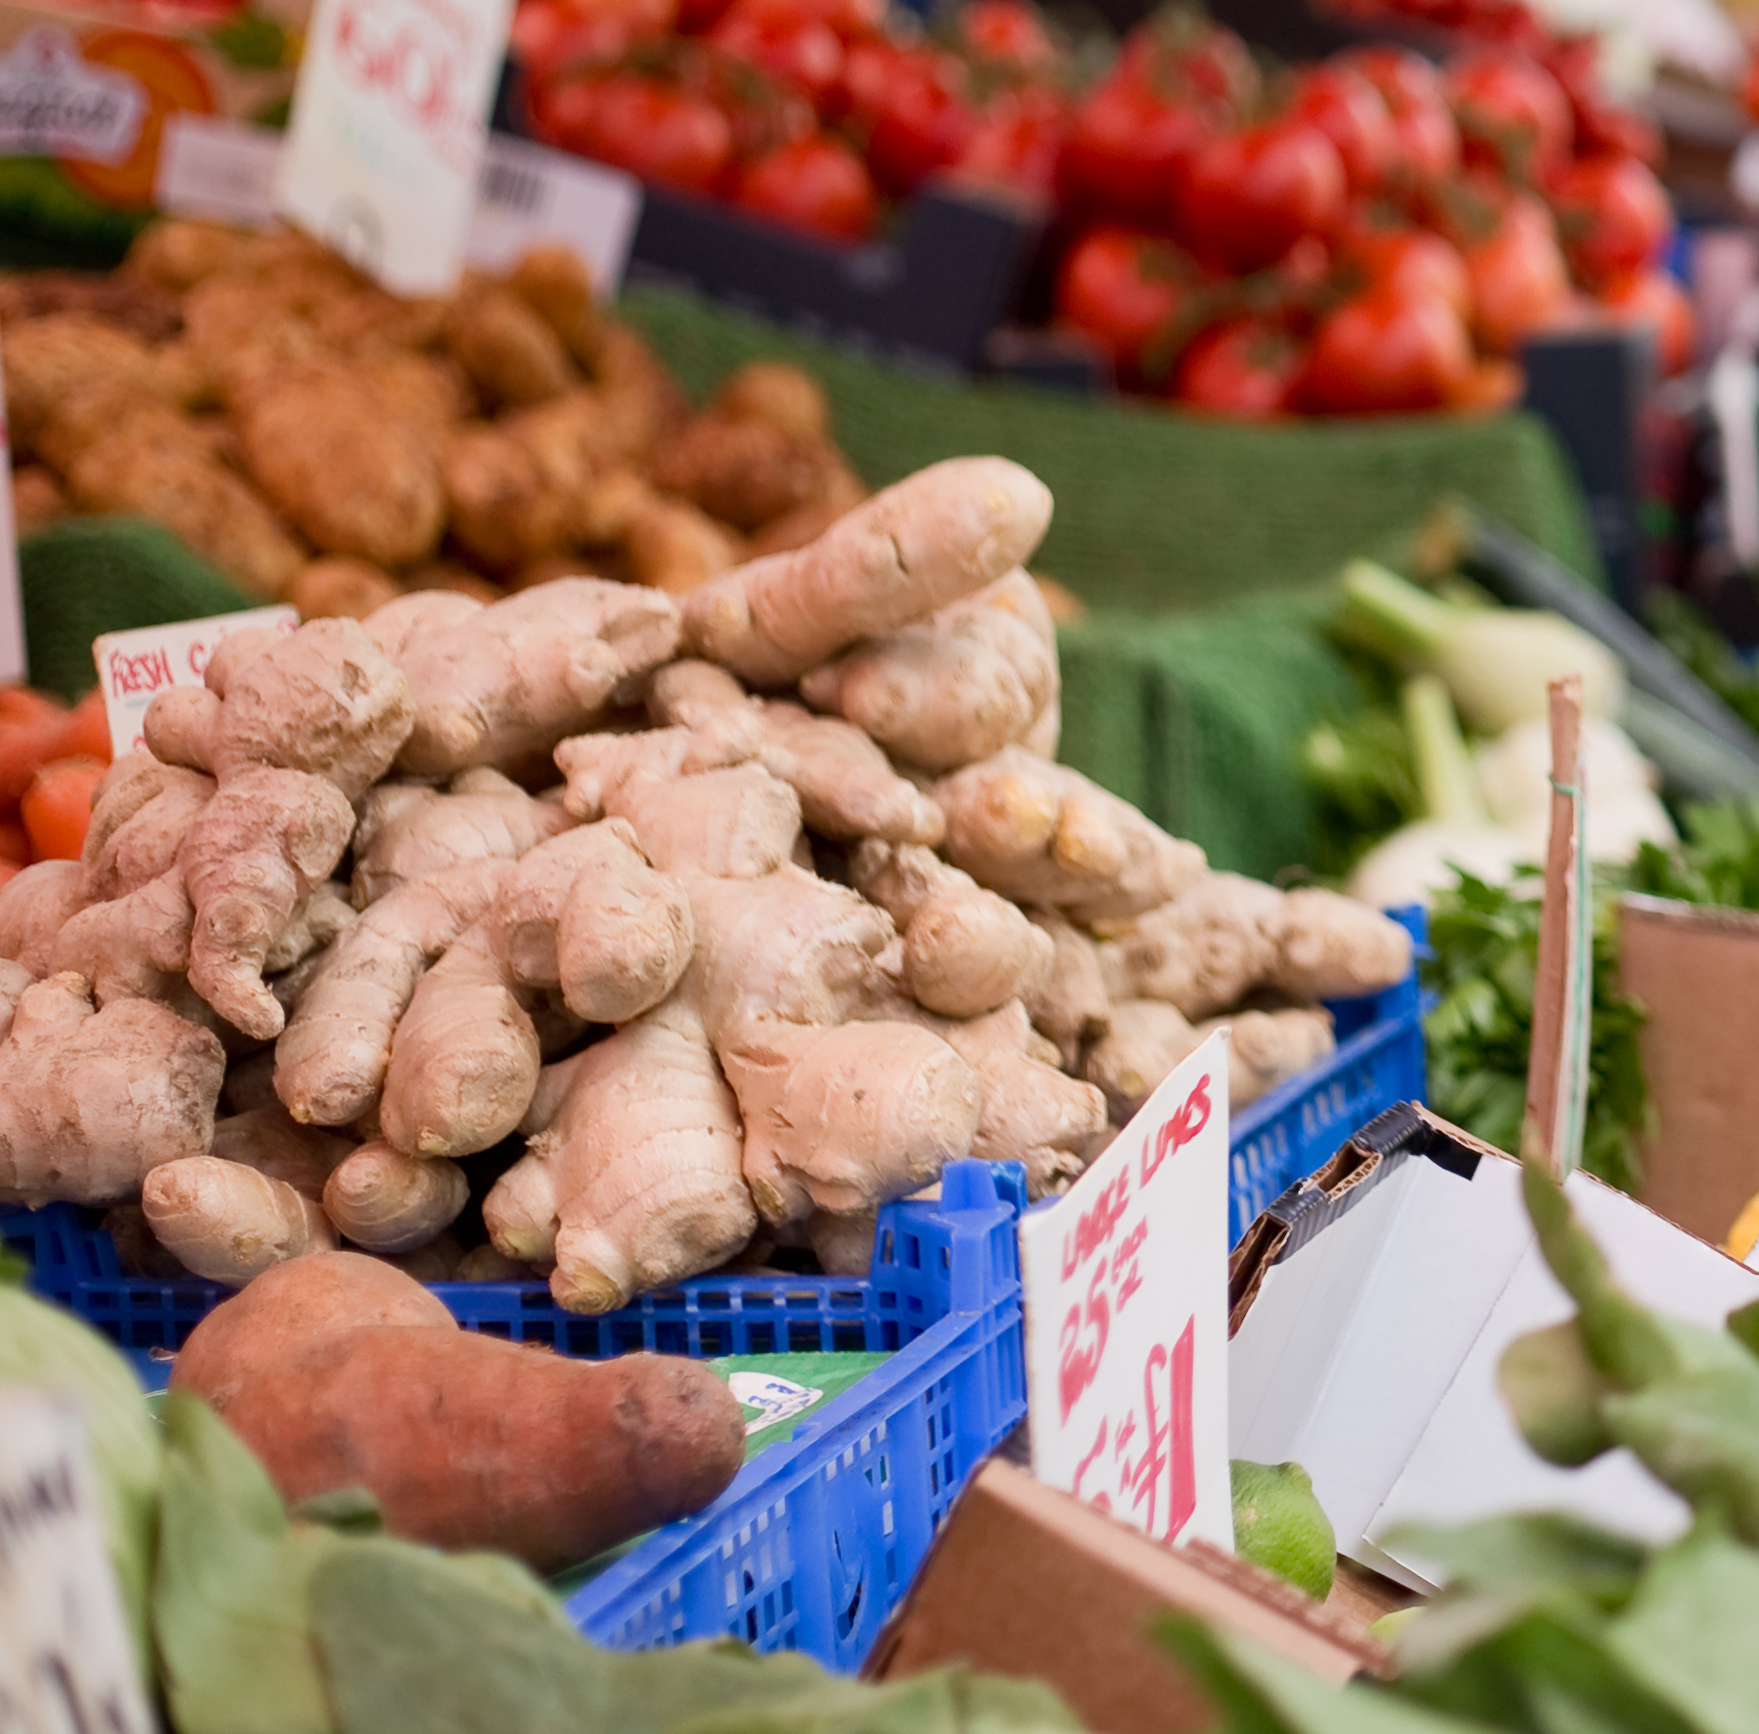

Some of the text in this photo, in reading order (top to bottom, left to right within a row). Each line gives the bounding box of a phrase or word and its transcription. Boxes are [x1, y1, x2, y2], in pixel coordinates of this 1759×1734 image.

[108, 645, 174, 698] FRESH
[1061, 1163, 1131, 1284] LARGE
[1058, 1254, 1110, 1429] 25
[1131, 1313, 1197, 1545] £1
